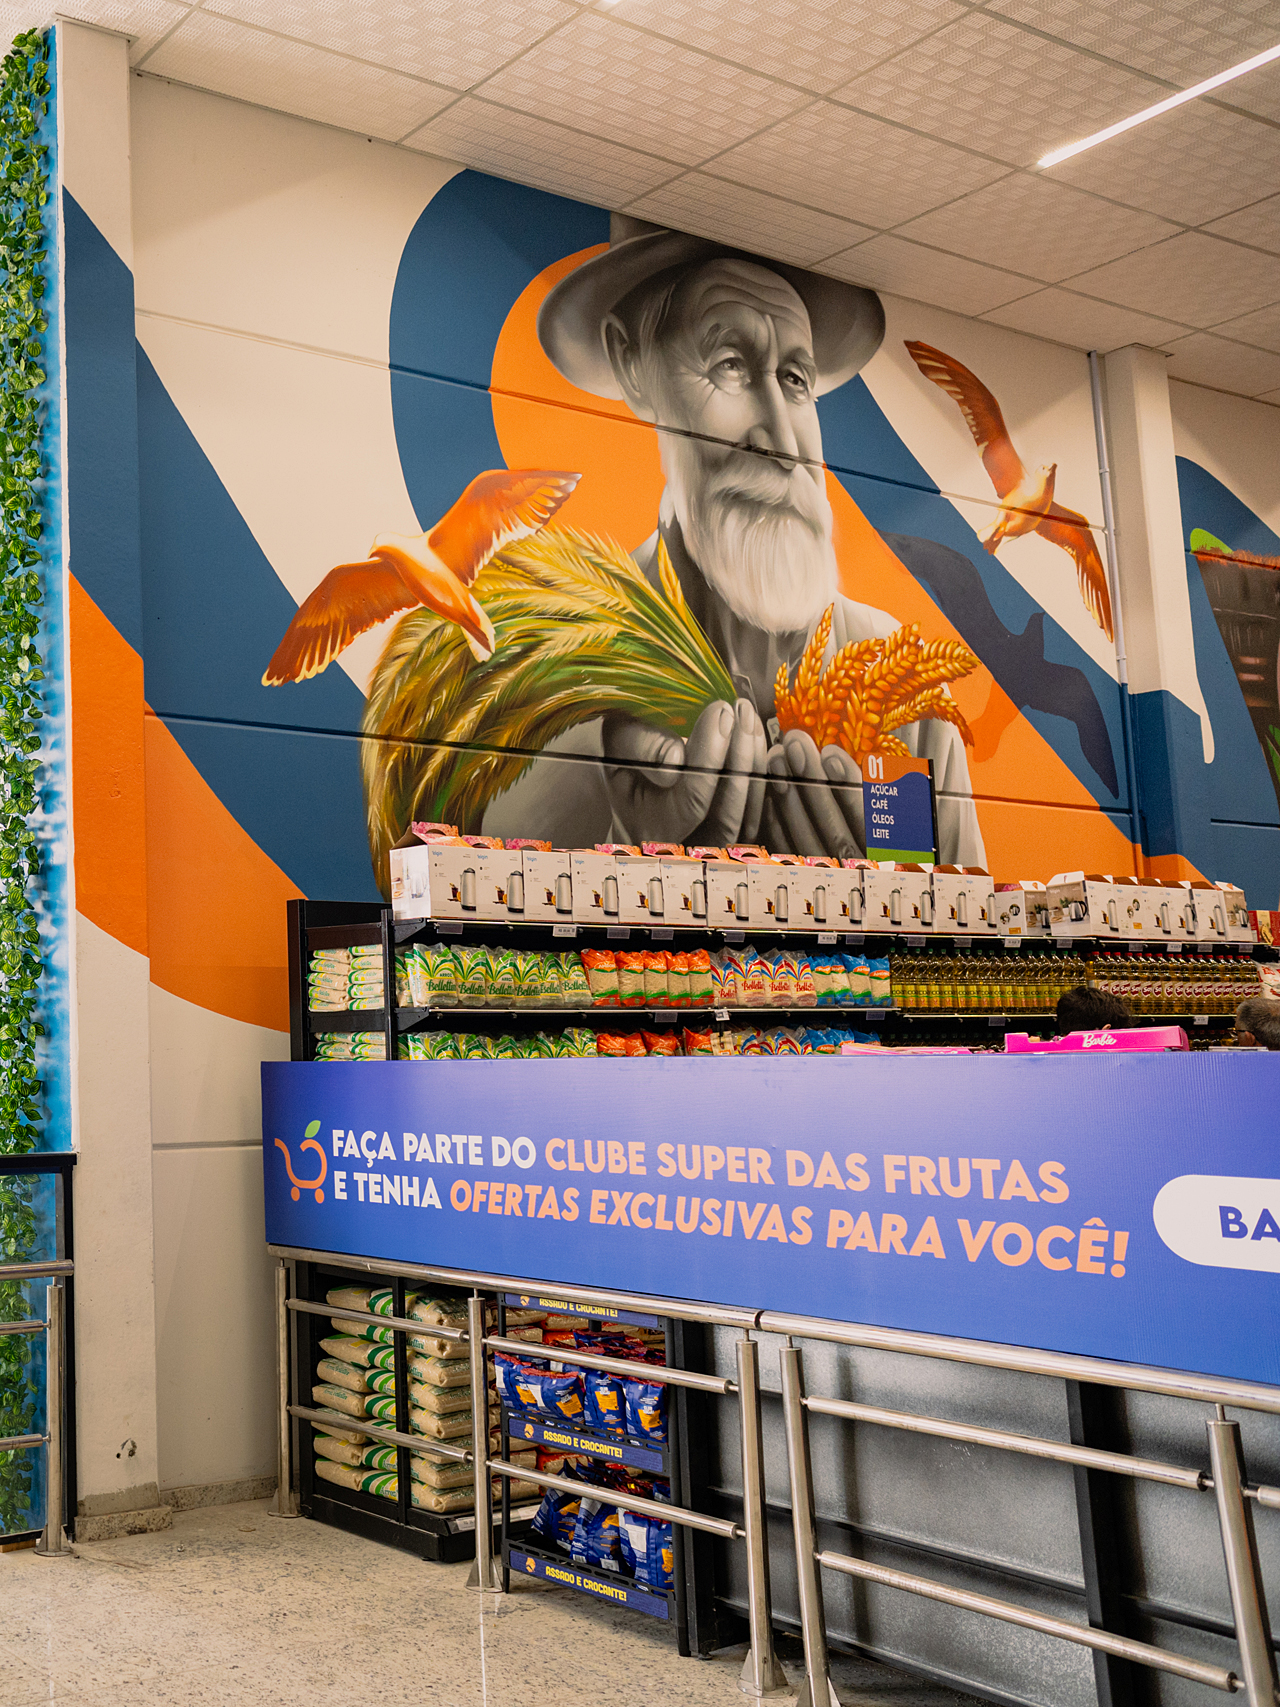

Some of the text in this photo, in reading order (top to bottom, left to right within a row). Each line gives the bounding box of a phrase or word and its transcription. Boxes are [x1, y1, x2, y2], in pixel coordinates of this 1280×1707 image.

[868, 755, 884, 779] 01
[871, 783, 898, 797] AÇÚCAR
[871, 798, 888, 810] CAFÉ
[872, 812, 894, 825] ÓLEOS
[873, 829, 890, 839] LEITE
[1082, 1033, 1117, 1048] Barbie
[332, 1129, 1070, 1204] FAÇA PARTE DO CLUBE SUPER DAS FRUTAS
[334, 1171, 1129, 1278] E TENHA OFERTAS EXCLUSIVAS PARA VOCÊ!
[539, 1298, 618, 1317] ASSADO E CROCANTE!
[544, 1430, 622, 1458] ASSADO E CROCANTE!
[546, 1566, 627, 1601] ASSADO E CROCANTE!
